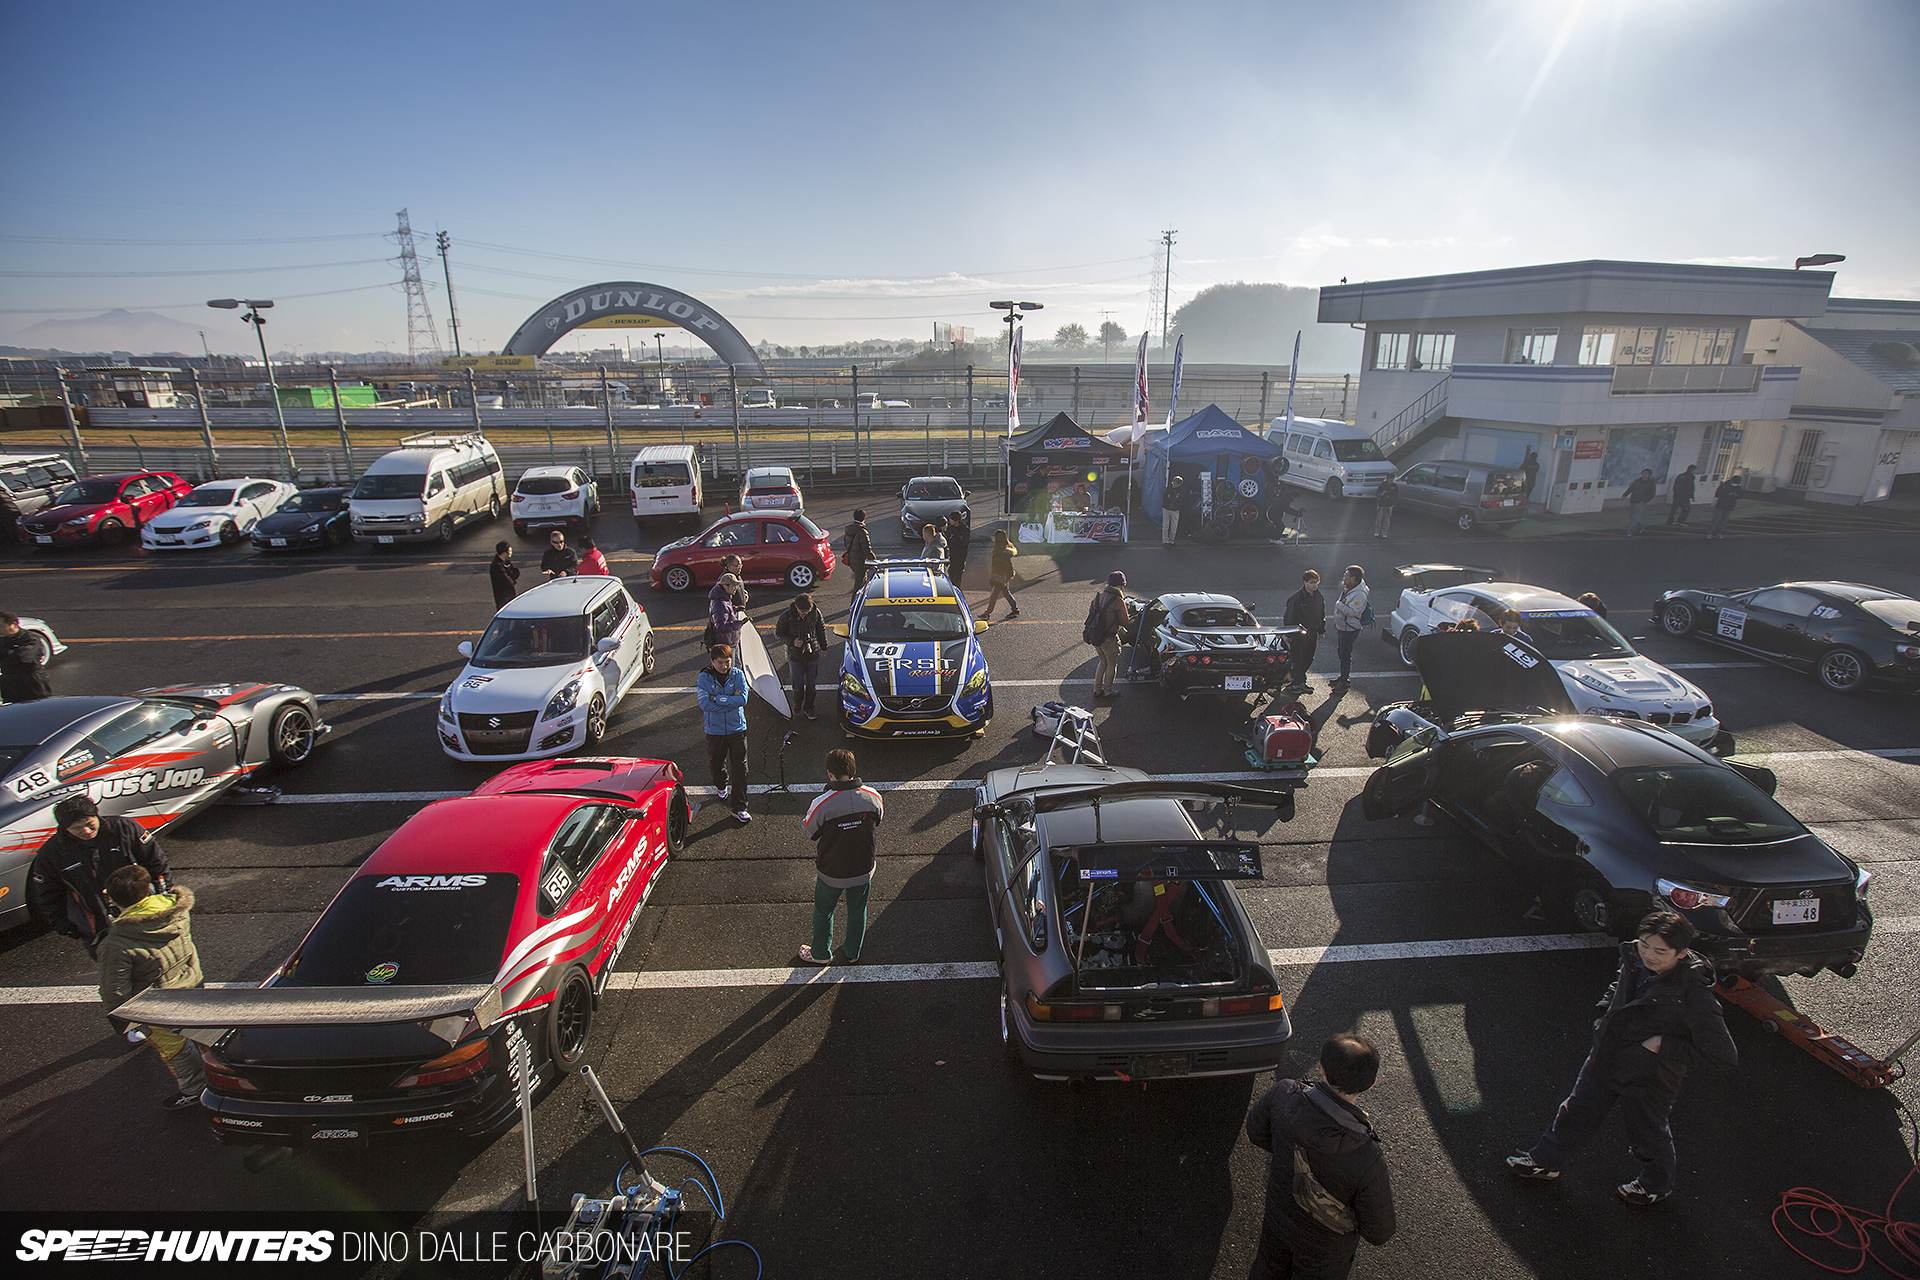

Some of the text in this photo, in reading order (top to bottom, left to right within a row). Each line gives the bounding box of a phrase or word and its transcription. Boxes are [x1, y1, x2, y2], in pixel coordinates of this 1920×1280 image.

[563, 290, 721, 331] DUNLOP
[495, 358, 521, 366] DUNLOP
[1044, 438, 1091, 449] WPC
[1073, 521, 1122, 538] WPC
[1722, 626, 1738, 637] 24
[872, 645, 899, 657] 40
[875, 658, 954, 671] ERST
[908, 668, 958, 677] Racing
[462, 680, 483, 689] 65
[17, 771, 49, 794] 48
[607, 835, 648, 912] ARMS
[375, 874, 488, 888] ARMS
[549, 871, 570, 900] 35
[1803, 907, 1817, 920] 48
